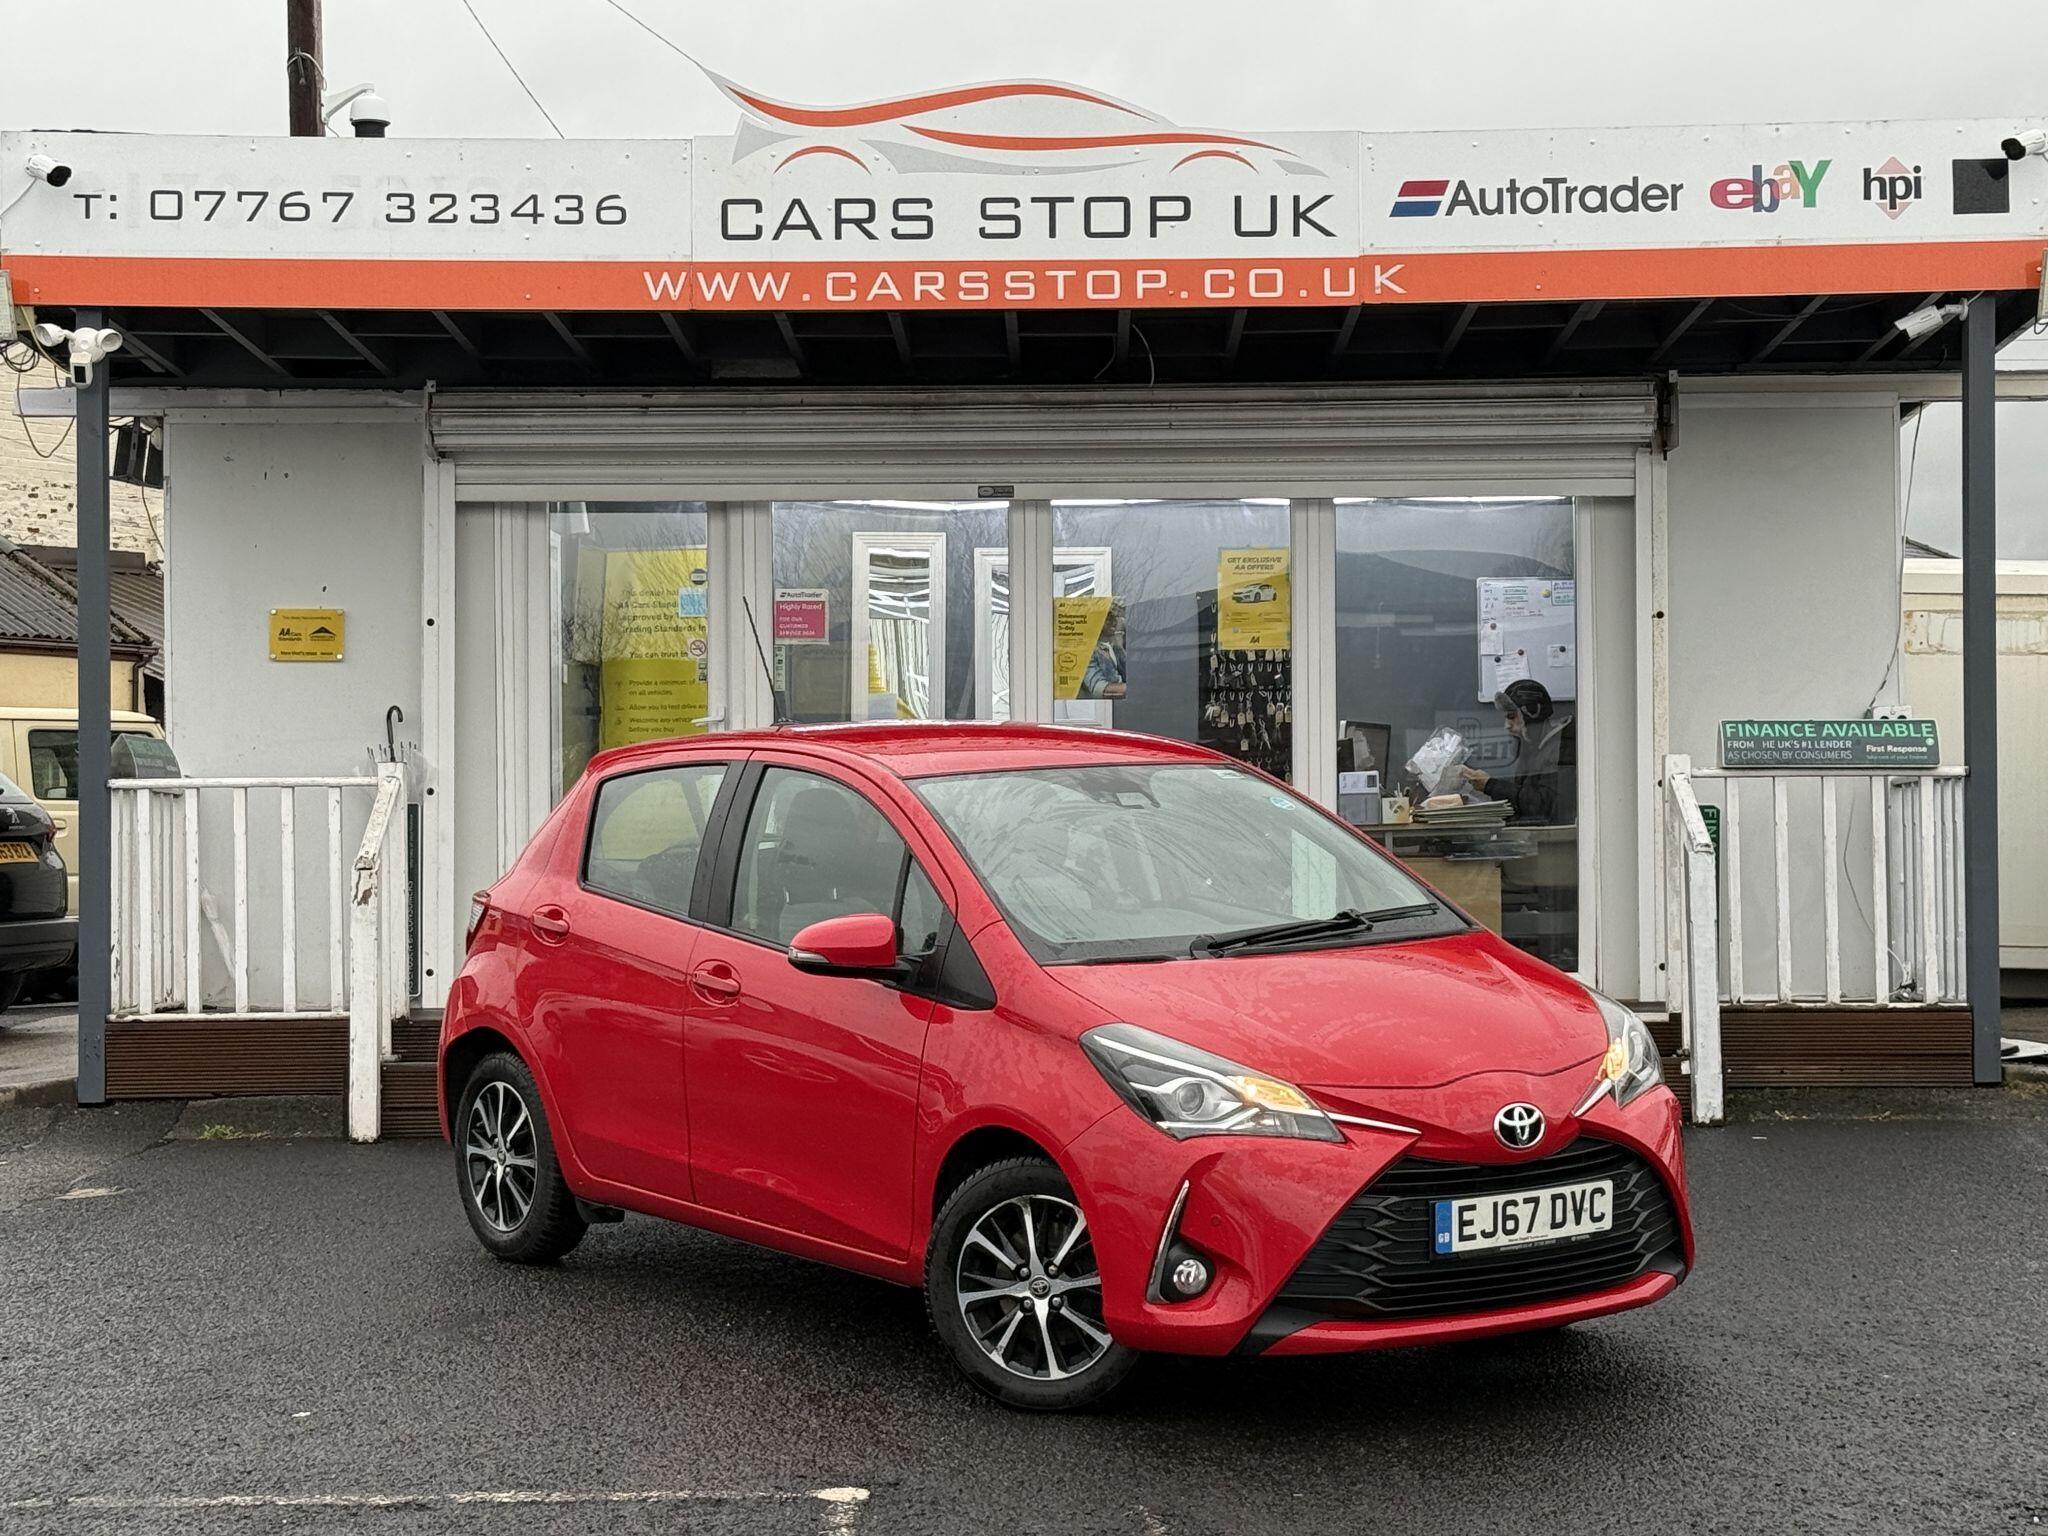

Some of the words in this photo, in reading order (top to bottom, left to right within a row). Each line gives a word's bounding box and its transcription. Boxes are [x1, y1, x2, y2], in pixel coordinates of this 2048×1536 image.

[1446, 176, 1684, 216] AutoTrader
[1863, 165, 1922, 210] hpi
[73, 194, 117, 219] T:
[150, 190, 354, 222] 07767
[385, 193, 627, 225] 323436
[721, 198, 934, 241] CARS
[979, 196, 1192, 240] STOP
[1234, 195, 1337, 238] UK
[643, 264, 1407, 301] WWW.CARSSTOP.CO.UK
[652, 600, 678, 609] Stand
[1725, 723, 1817, 738] FINANCE
[1821, 723, 1934, 738] AVAILABLE
[1727, 740, 1755, 749] FROM
[1761, 740, 1776, 749] HE
[1777, 740, 1800, 749] UK'S
[1814, 740, 1852, 749] LENDER
[1727, 750, 1740, 760] AS
[1741, 750, 1780, 760] CHOSEN
[1781, 750, 1793, 760] BY
[1794, 750, 1853, 760] CONSUMERS
[1886, 745, 1928, 754] Response
[1458, 1195, 1541, 1243] EJ67
[1550, 1186, 1606, 1230] DVC
[1438, 1232, 1450, 1243] GB
